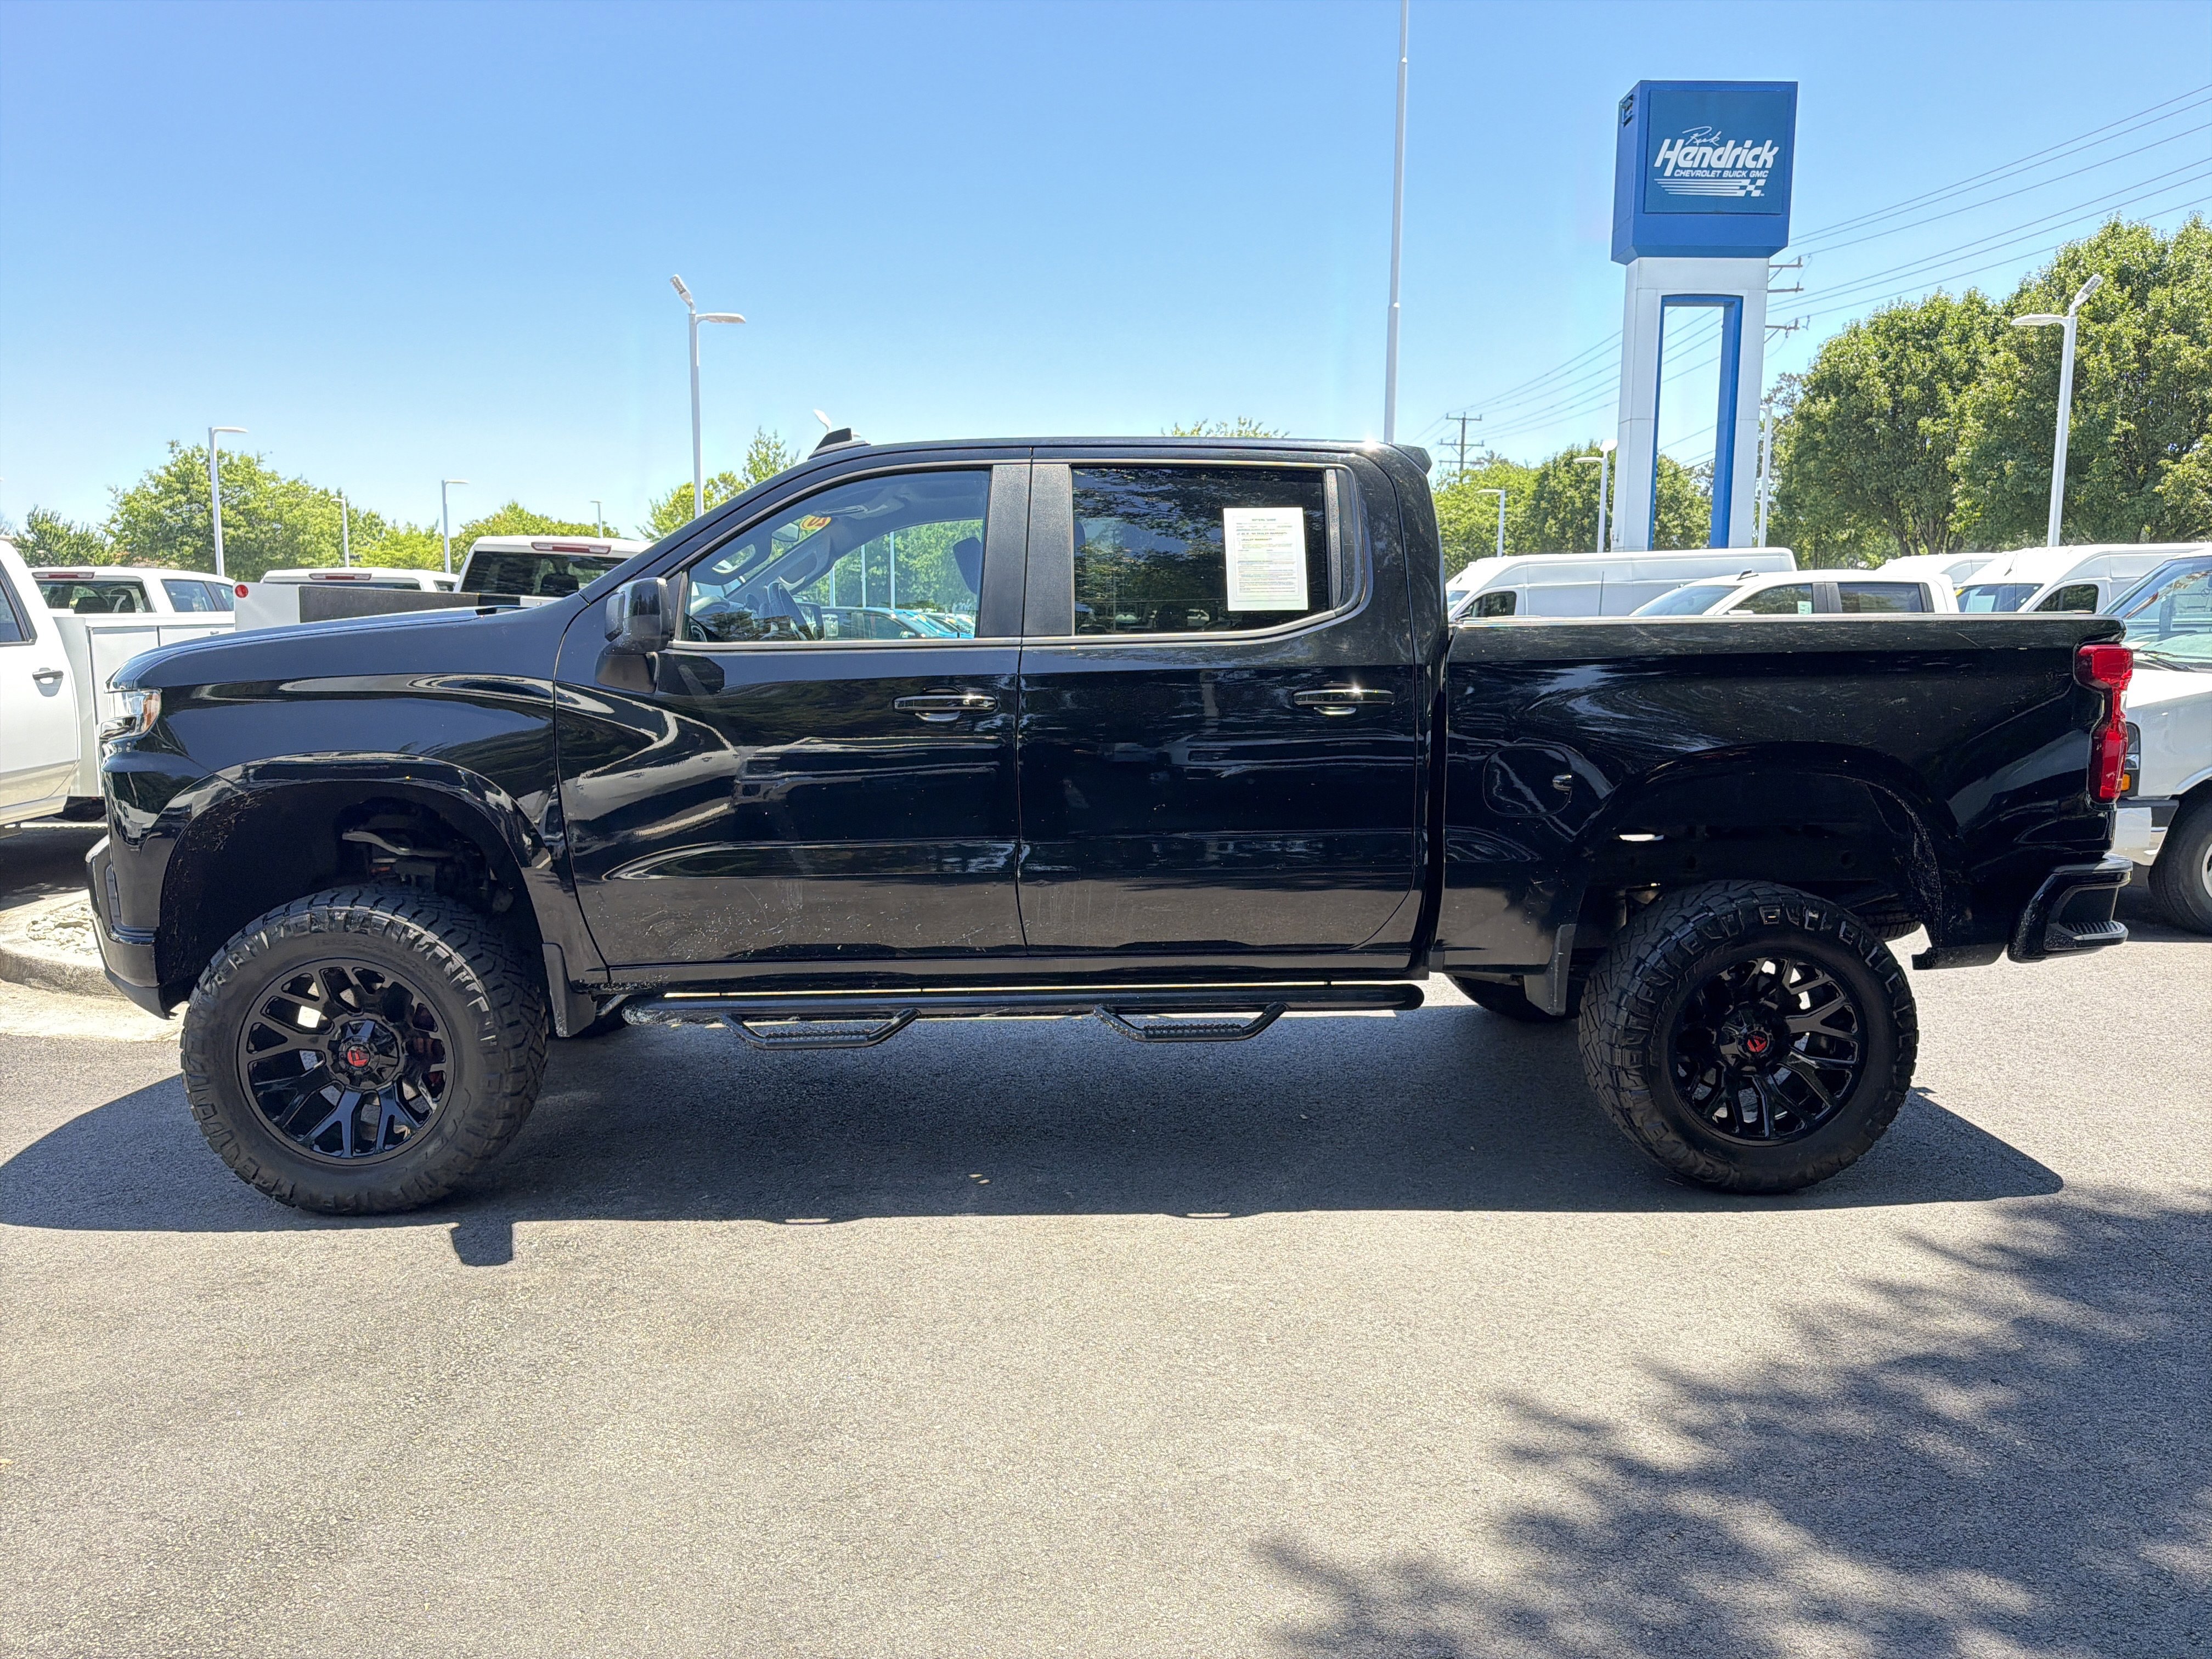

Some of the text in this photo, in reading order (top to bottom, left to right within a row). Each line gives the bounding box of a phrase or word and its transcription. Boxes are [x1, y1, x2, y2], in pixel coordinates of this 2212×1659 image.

[1654, 138, 1780, 177] Hendrick
[1674, 168, 1769, 178] CHEVROLET BUICK GMC
